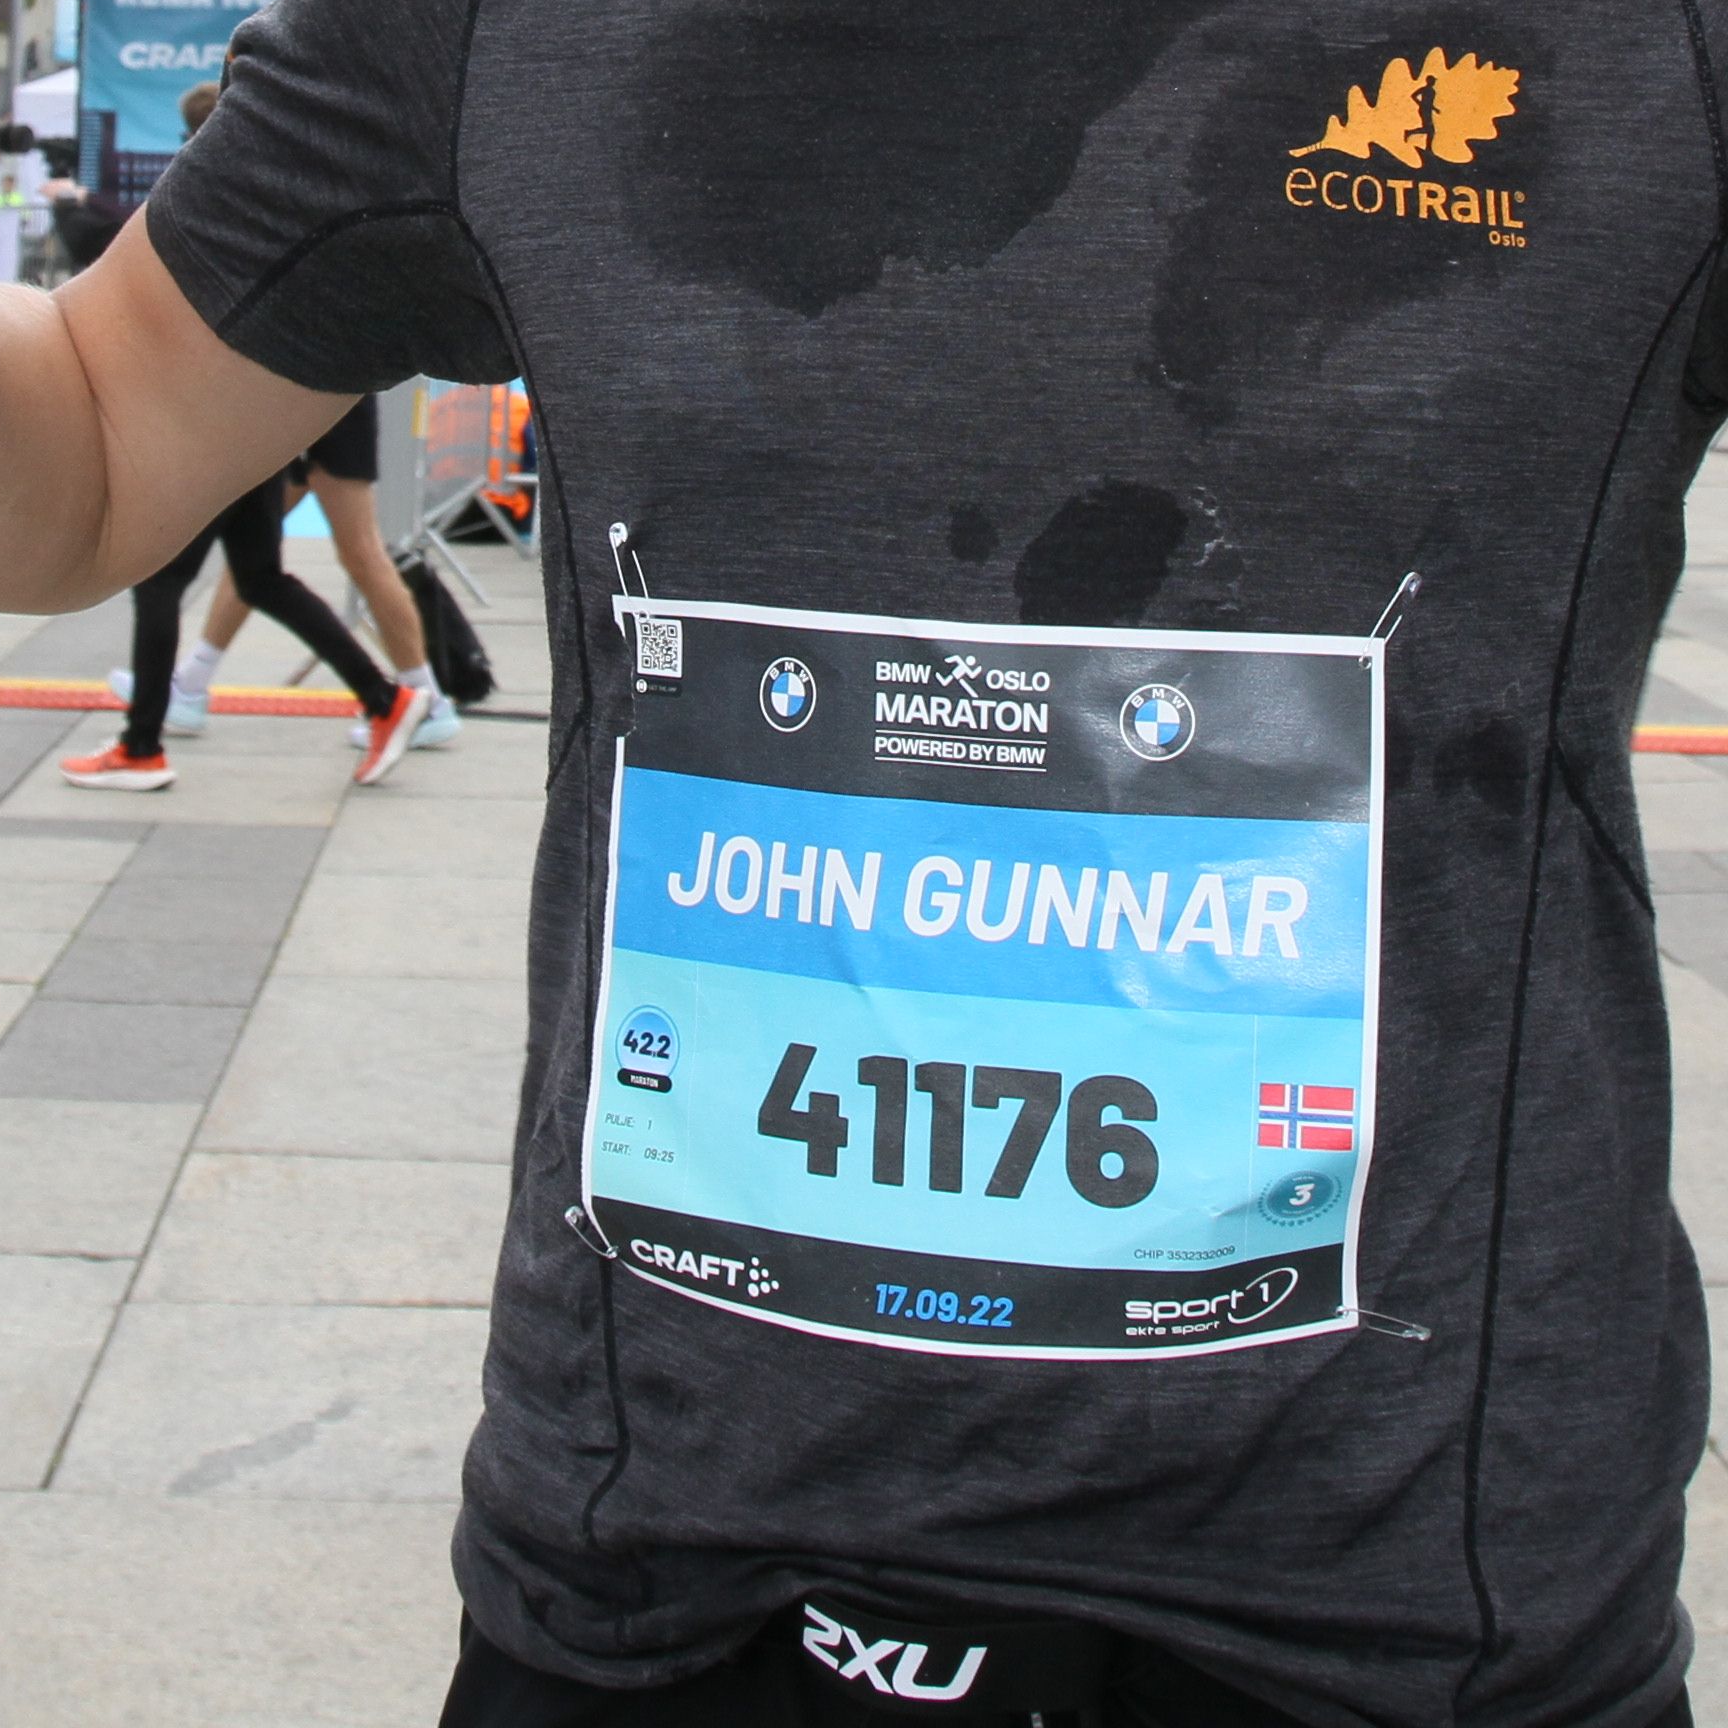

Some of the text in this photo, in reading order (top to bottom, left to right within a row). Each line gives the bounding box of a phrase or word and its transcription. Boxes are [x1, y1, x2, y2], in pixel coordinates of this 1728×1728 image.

[119, 40, 229, 70] CRAF
[1488, 230, 1526, 249] Oslo
[770, 661, 810, 683] BMW
[876, 661, 1051, 692] BMW OSLO
[1131, 687, 1186, 709] BMW
[875, 692, 1049, 734] MARATON
[875, 736, 1047, 765] POWERED BY BMW
[667, 830, 1309, 960] JOHN GUNNAR
[604, 1113, 634, 1129] PULJE:
[757, 1042, 1160, 1209] 41176
[601, 1140, 674, 1164] START: 09:25
[1288, 1183, 1315, 1207] 3
[630, 1239, 744, 1287] CRAFT
[1134, 1248, 1164, 1260] CHIP
[876, 1283, 1014, 1328] 17.09.22
[1125, 1289, 1245, 1325] sport
[1125, 1321, 1221, 1337] ekte sport
[802, 1602, 988, 1702] 2XU
